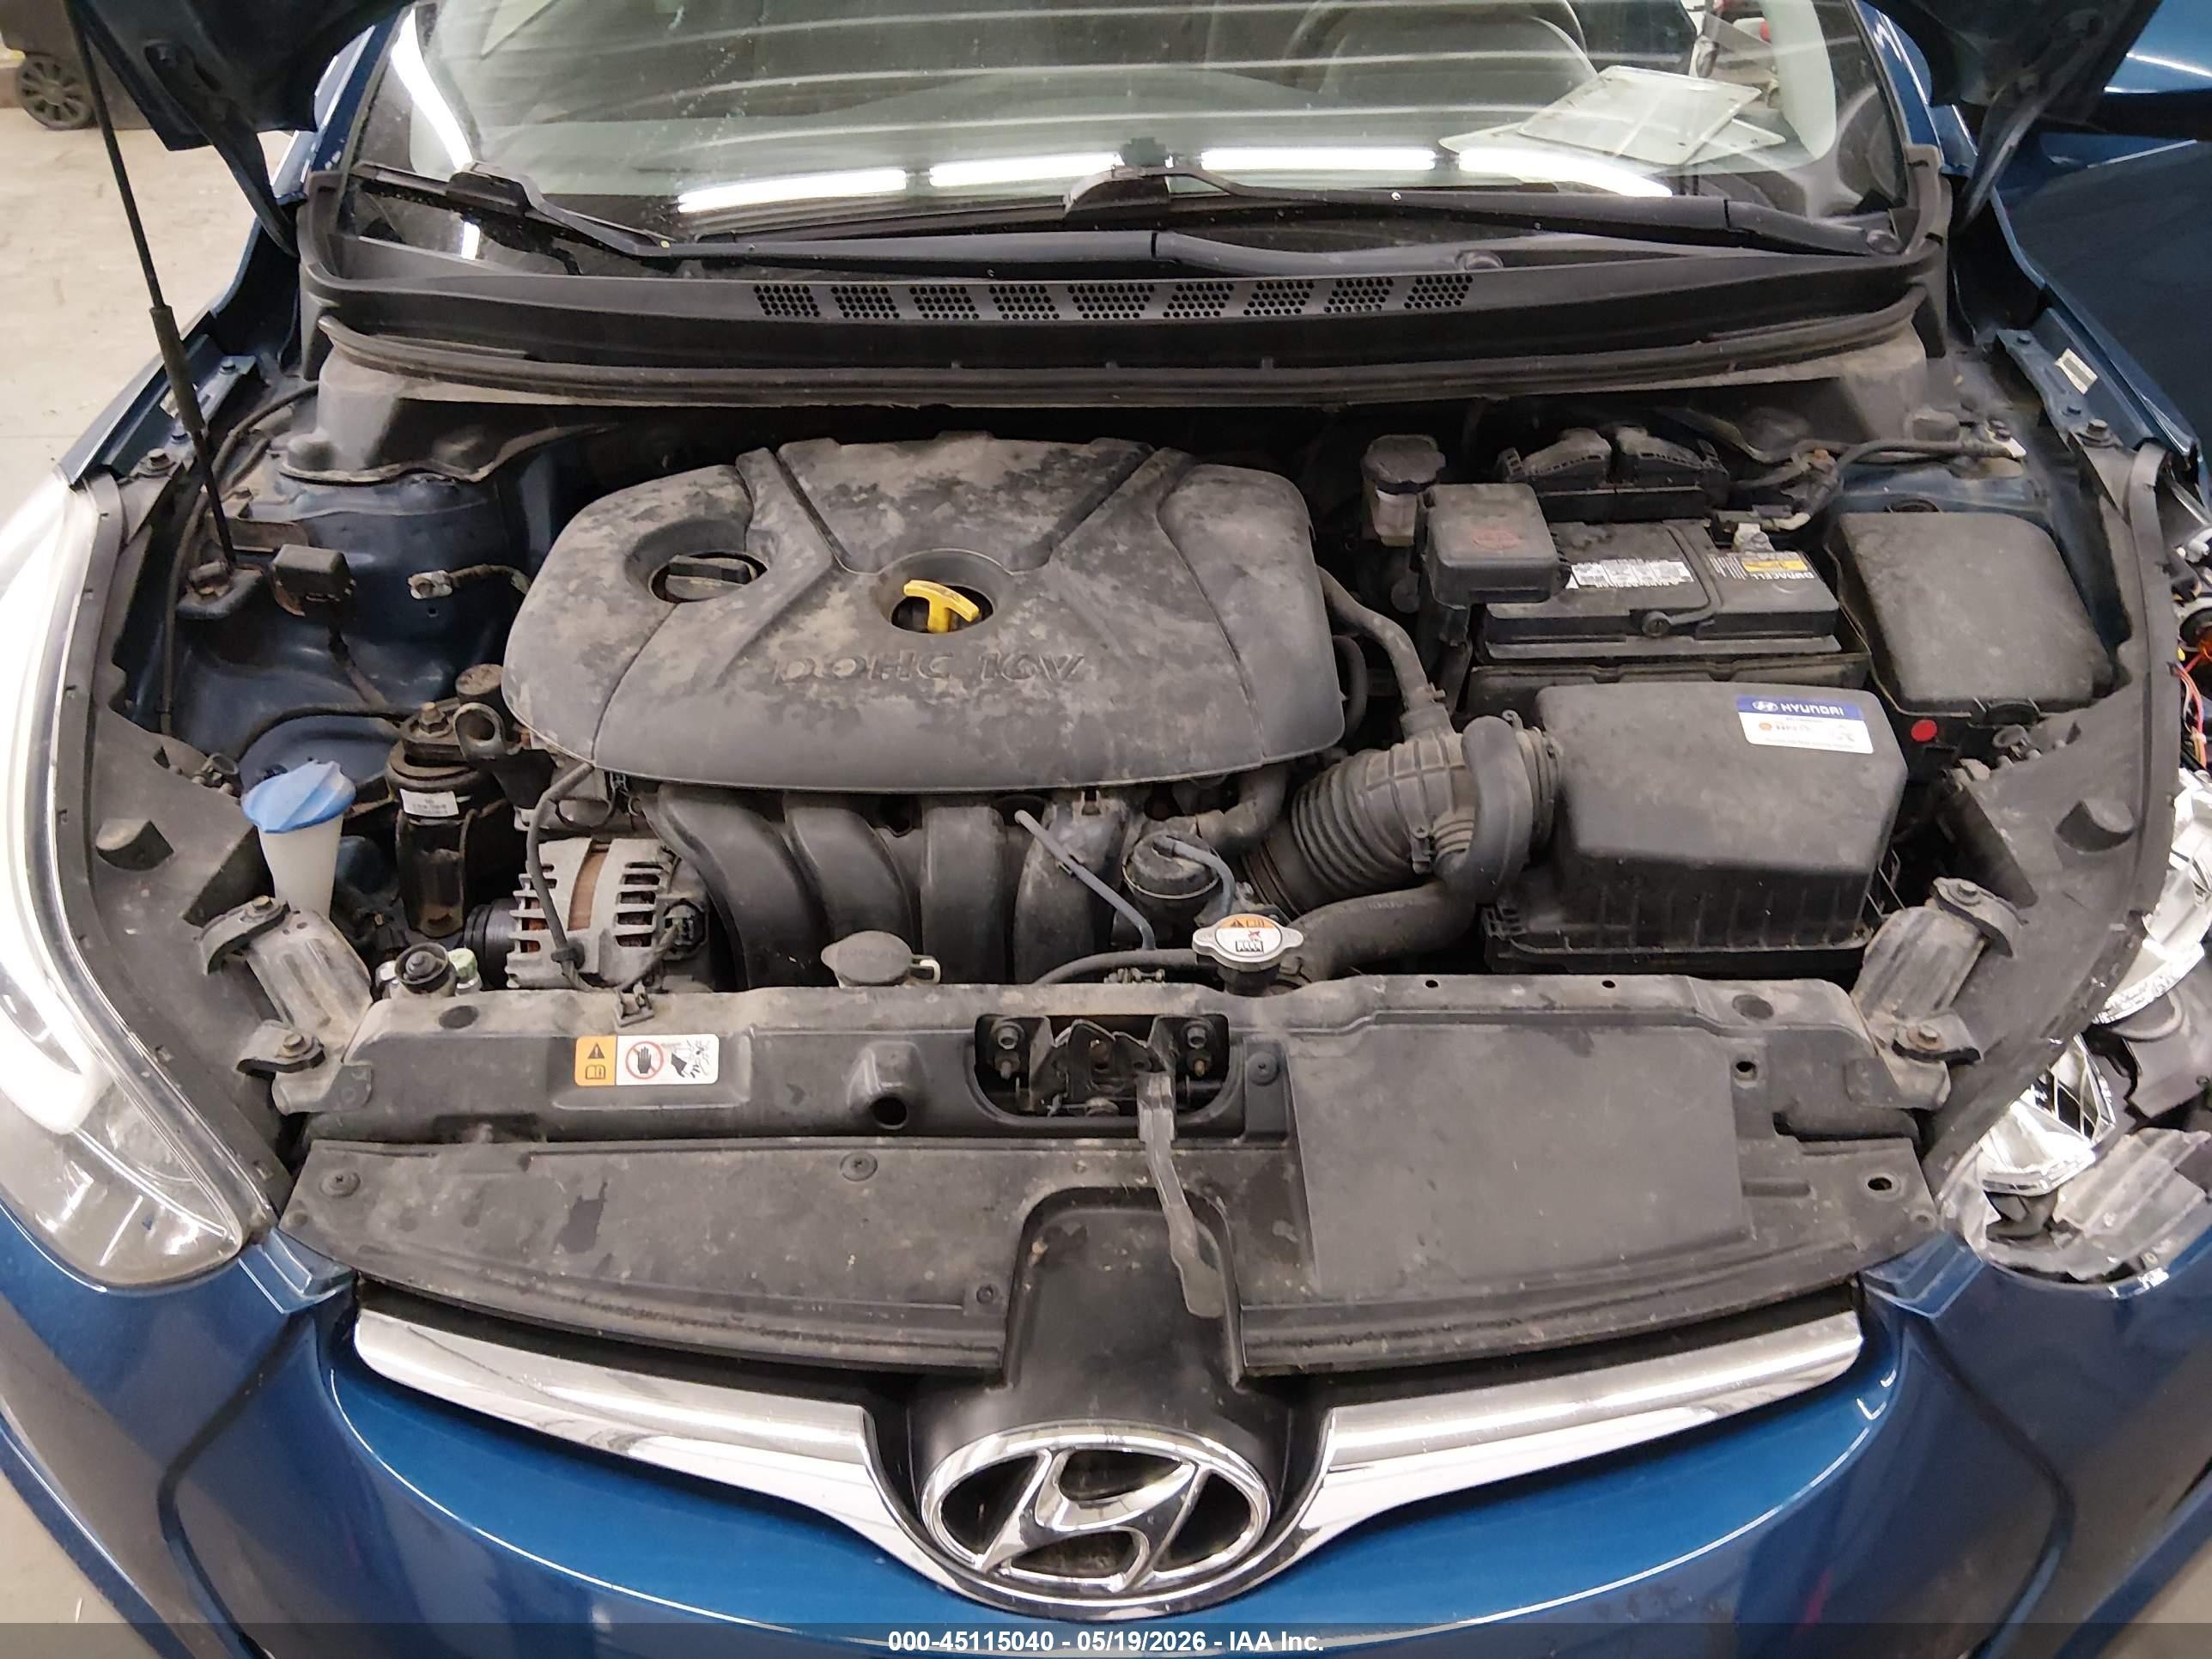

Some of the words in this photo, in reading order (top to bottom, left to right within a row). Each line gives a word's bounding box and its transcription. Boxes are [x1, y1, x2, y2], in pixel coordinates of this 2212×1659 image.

[1751, 571, 1814, 580] DURACELL
[774, 649, 954, 684] DOHC
[978, 651, 1085, 682] 16V
[1780, 702, 1845, 716] HYUNDAI
